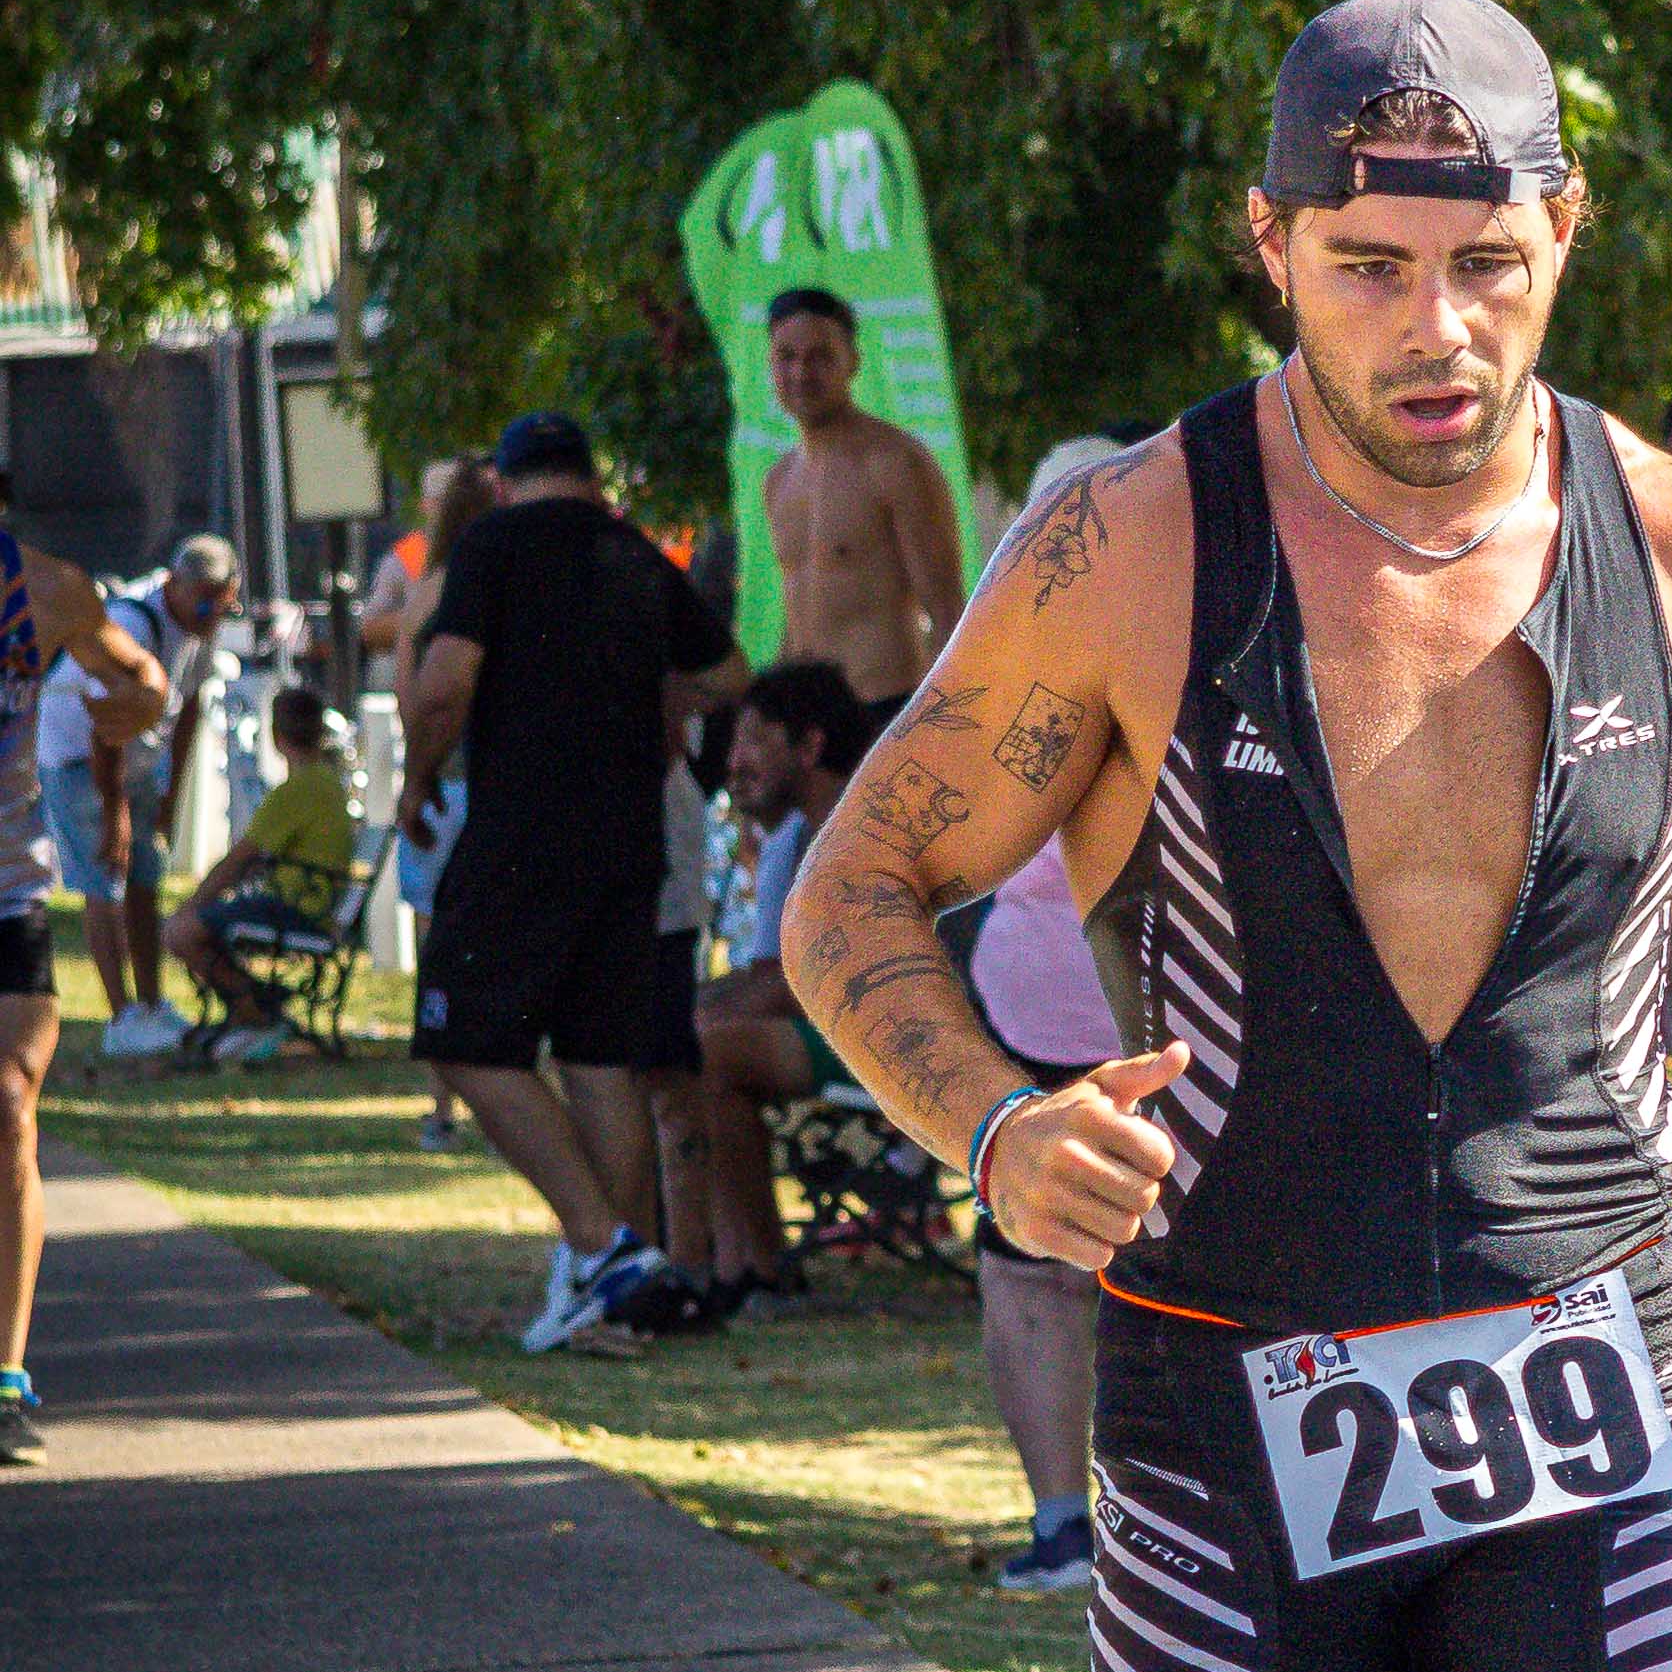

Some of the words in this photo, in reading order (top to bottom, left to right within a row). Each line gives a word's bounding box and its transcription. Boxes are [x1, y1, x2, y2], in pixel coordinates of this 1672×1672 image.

[1564, 1284, 1608, 1310] sai
[1299, 1336, 1652, 1562] 299
[1130, 1531, 1200, 1574] PRO
